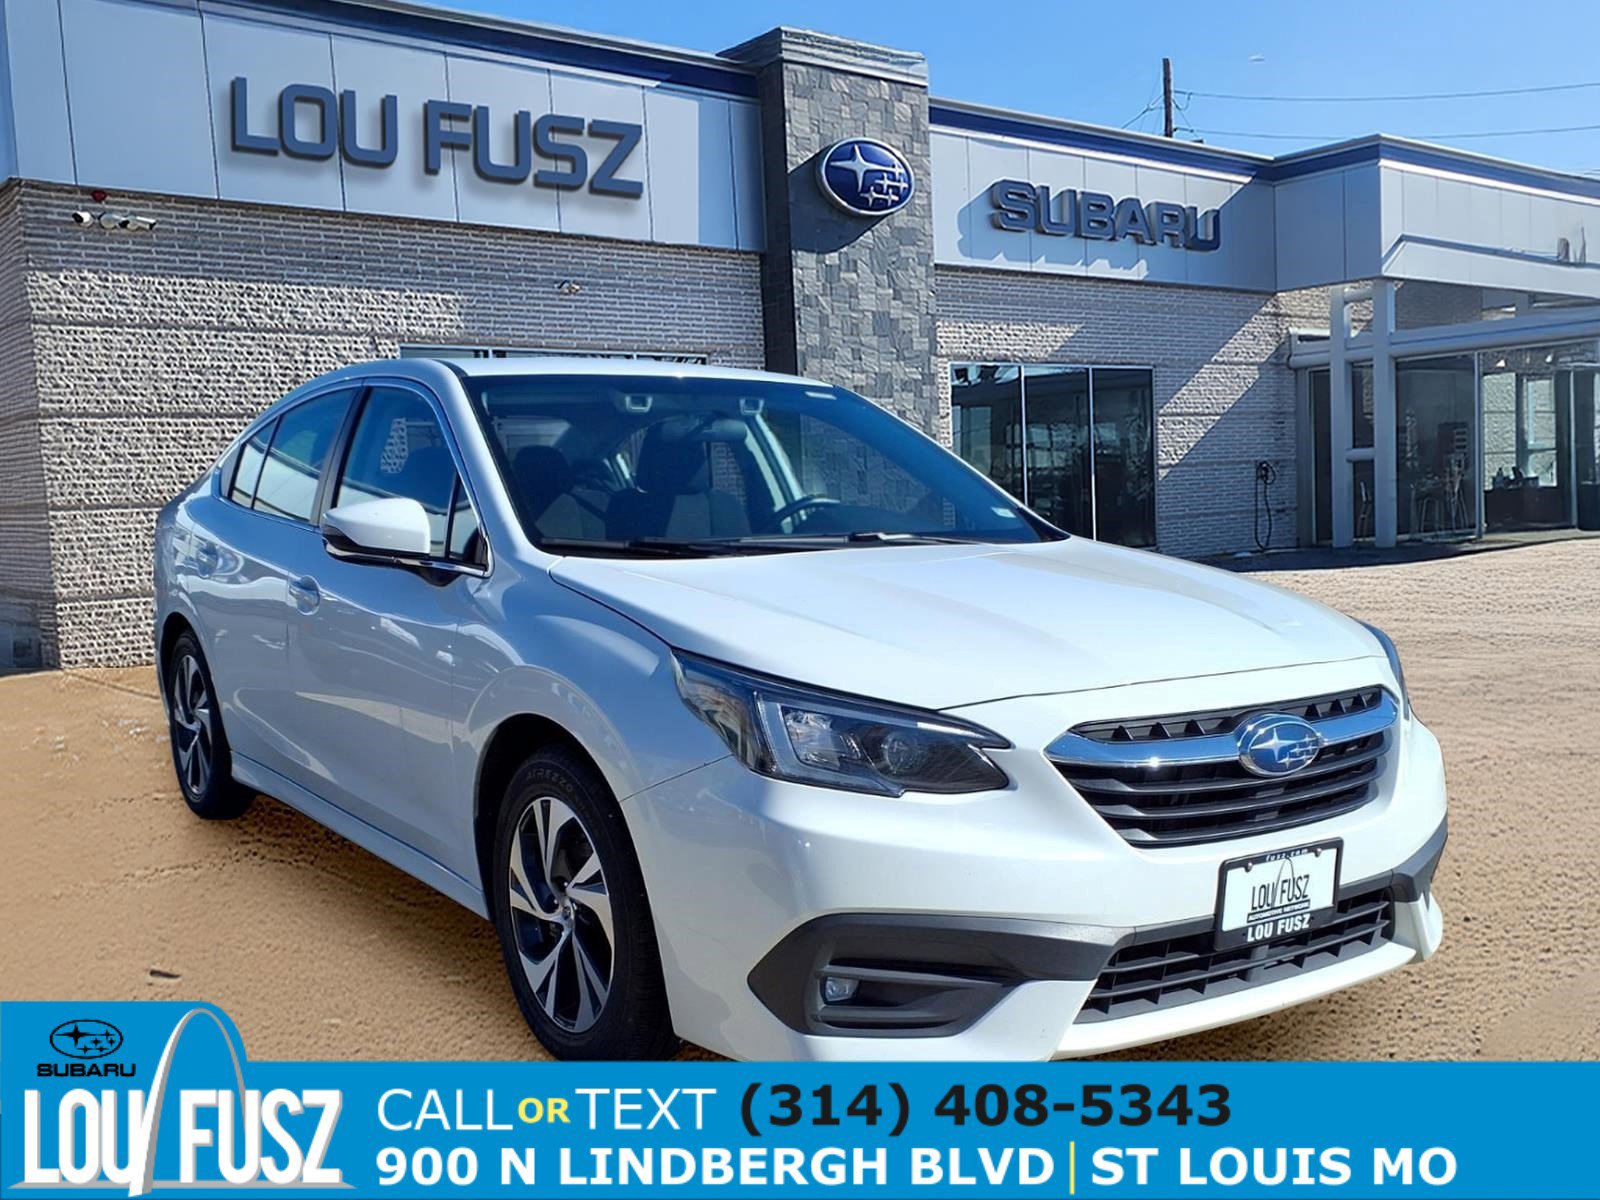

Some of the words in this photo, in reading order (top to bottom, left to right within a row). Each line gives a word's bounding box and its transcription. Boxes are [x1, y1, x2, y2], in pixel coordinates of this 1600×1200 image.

[231, 76, 398, 168] LOU
[424, 99, 643, 198] FUSZ
[989, 179, 1221, 250] SUBARU
[1252, 882, 1276, 911] LOU
[1279, 874, 1310, 904] FUSZ
[1247, 922, 1273, 942] LOU
[1277, 914, 1310, 935] FUSZ
